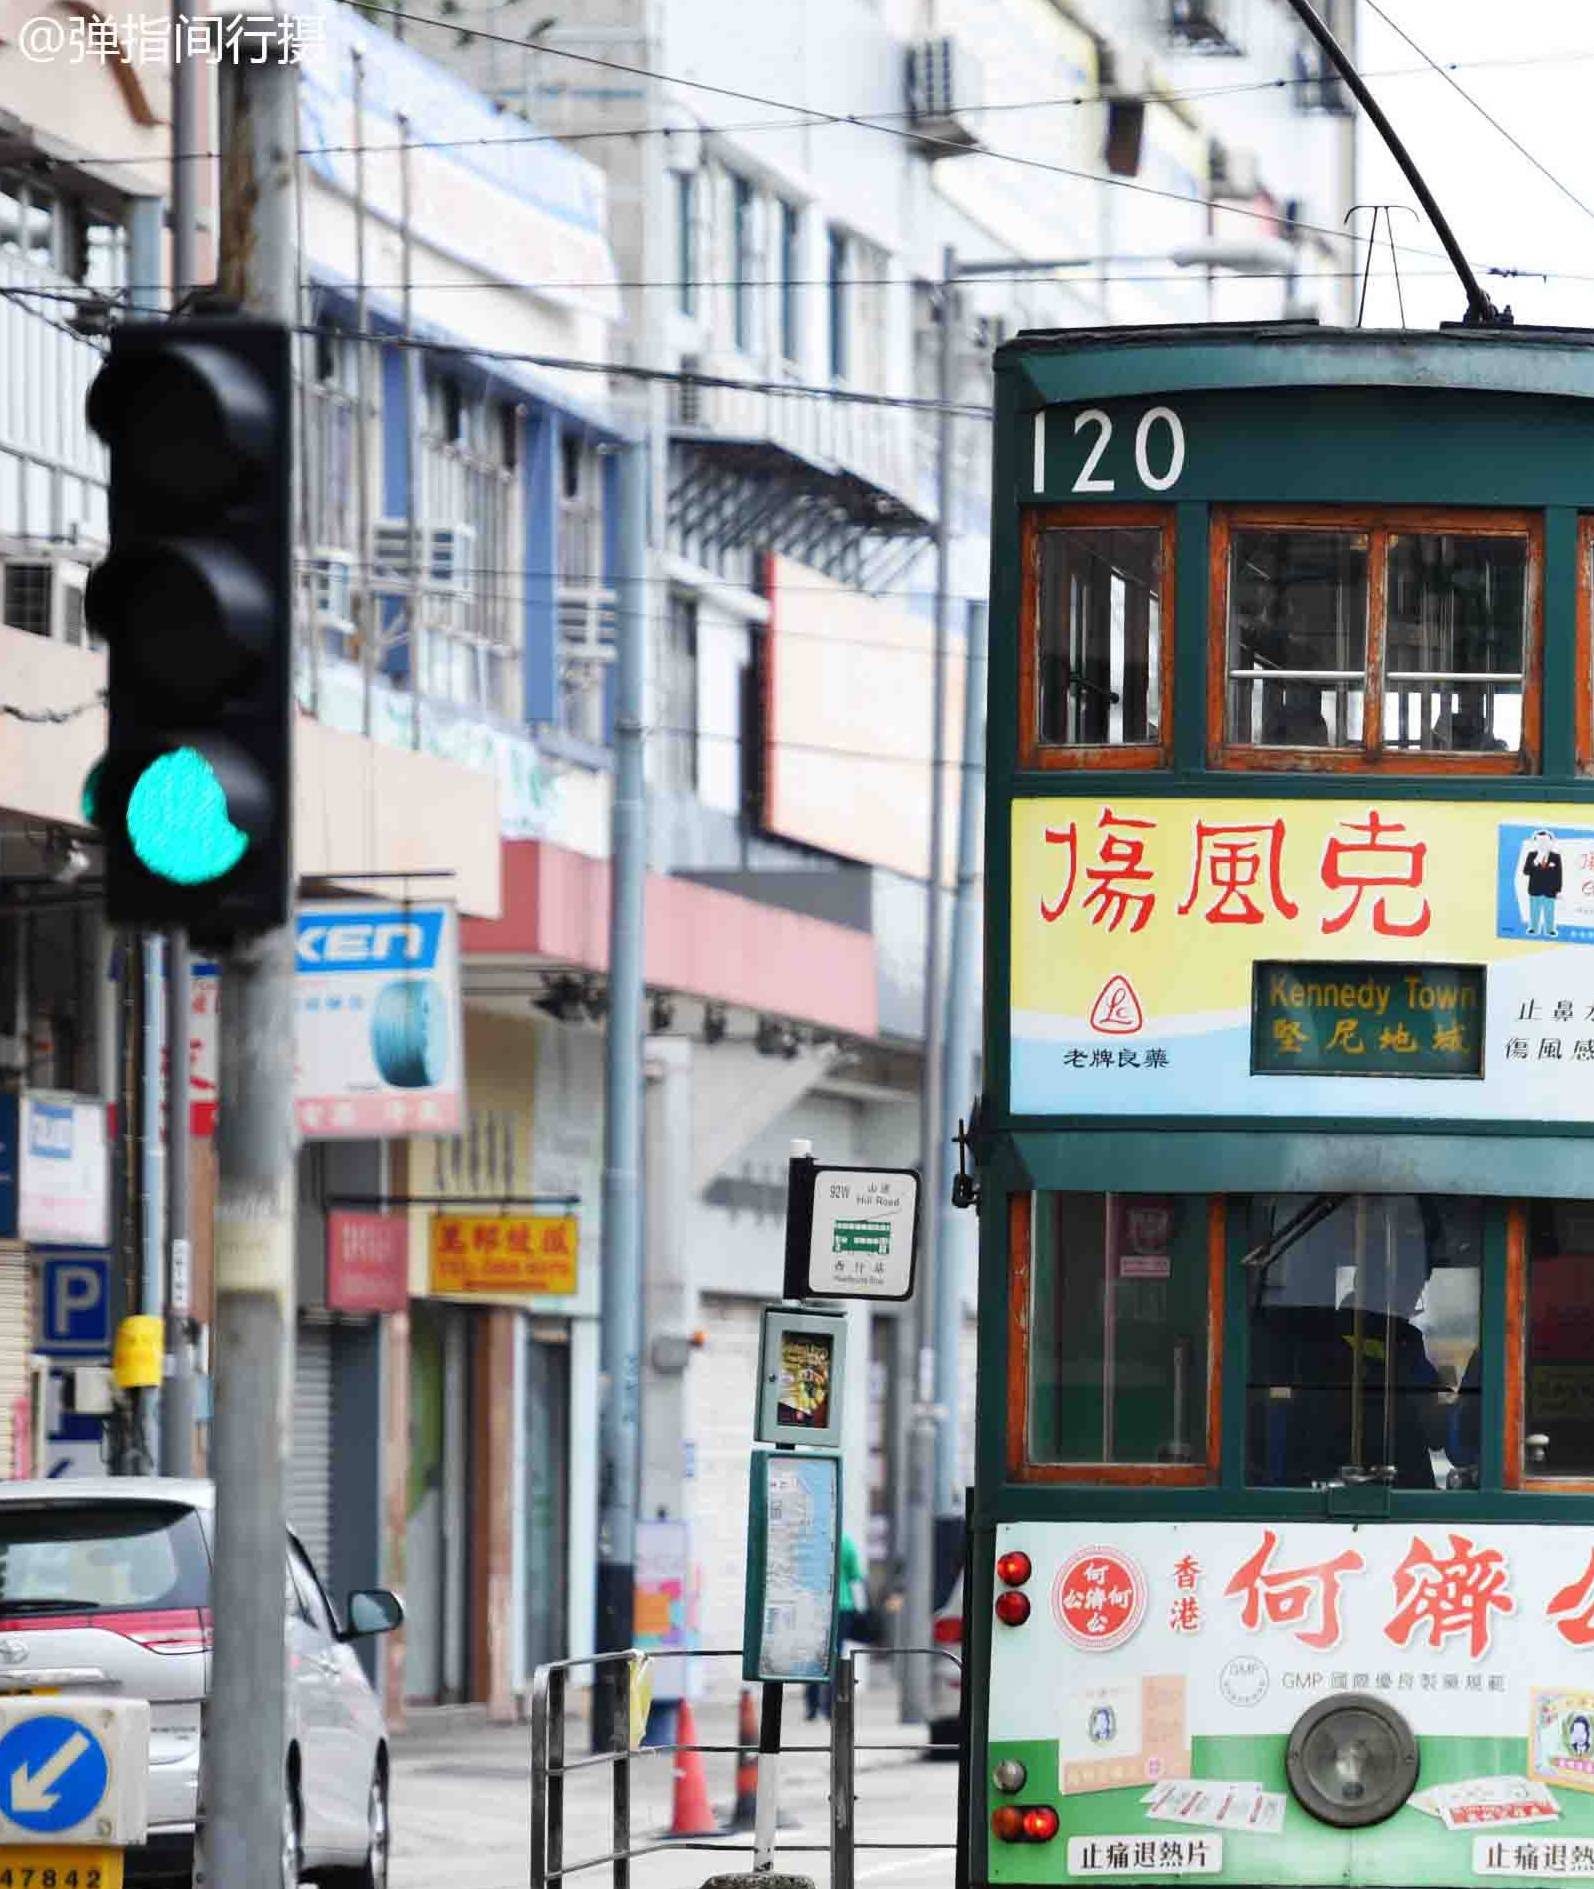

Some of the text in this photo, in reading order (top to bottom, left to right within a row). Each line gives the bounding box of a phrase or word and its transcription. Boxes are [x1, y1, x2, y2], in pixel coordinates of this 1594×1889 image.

[1033, 406, 1185, 494] 120
[1040, 807, 1431, 937] 傷風克
[1271, 976, 1478, 1015] Kennedy Town
[1062, 1047, 1171, 1070] 老牌良藥
[876, 1196, 900, 1207] Road
[54, 1266, 101, 1335] P
[1168, 1554, 1202, 1631] 香港
[1281, 1672, 1324, 1690] GMP
[1080, 1840, 1212, 1870] 止痛退熱片
[0, 1867, 101, 1888] 47842
